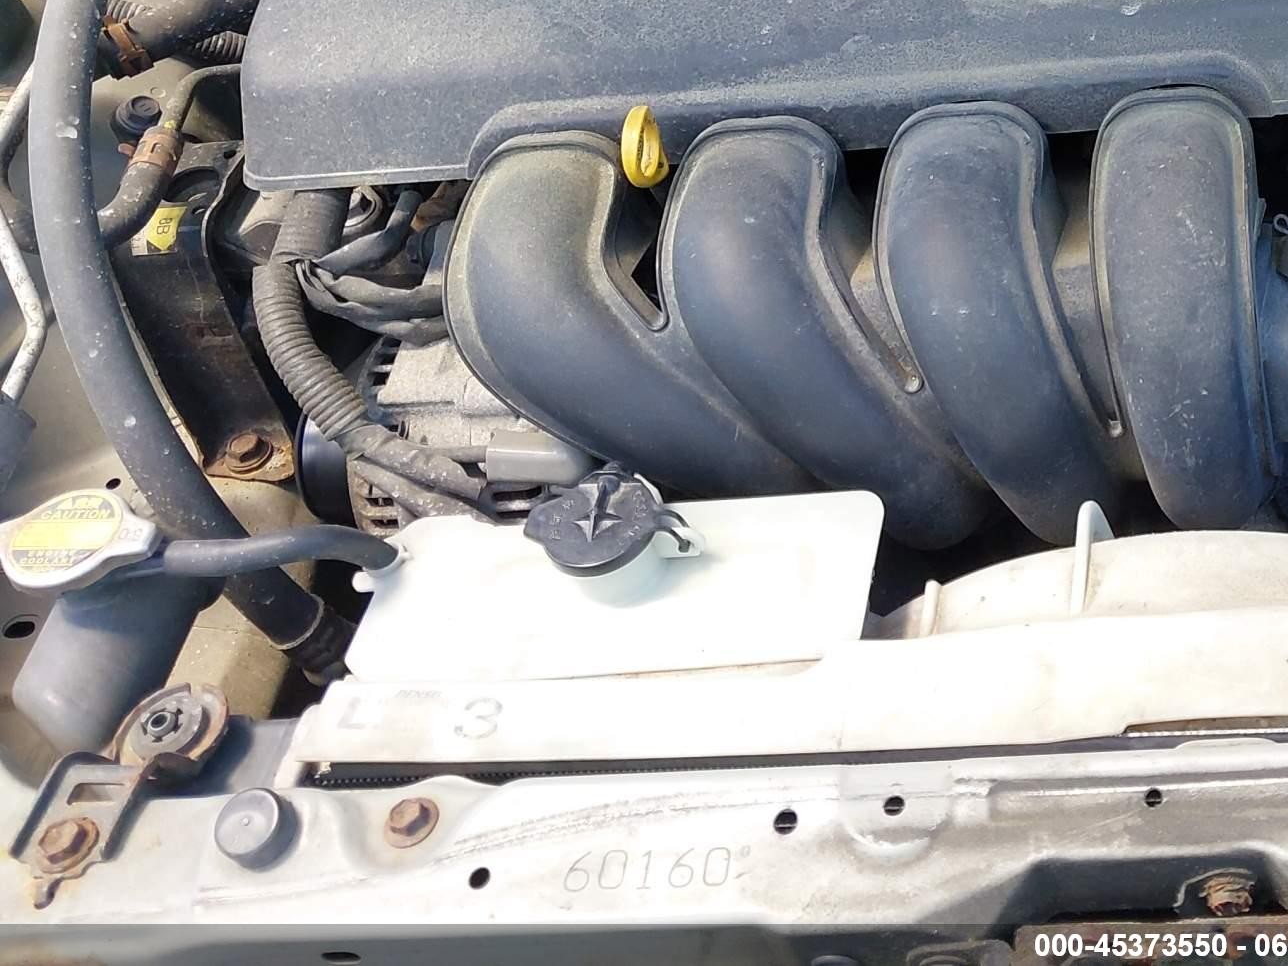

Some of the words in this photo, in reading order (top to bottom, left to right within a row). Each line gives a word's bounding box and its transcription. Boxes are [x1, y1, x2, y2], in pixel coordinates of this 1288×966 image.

[41, 508, 111, 520] CAUTION
[20, 557, 75, 565] COOLANT
[563, 846, 731, 893] 60160
